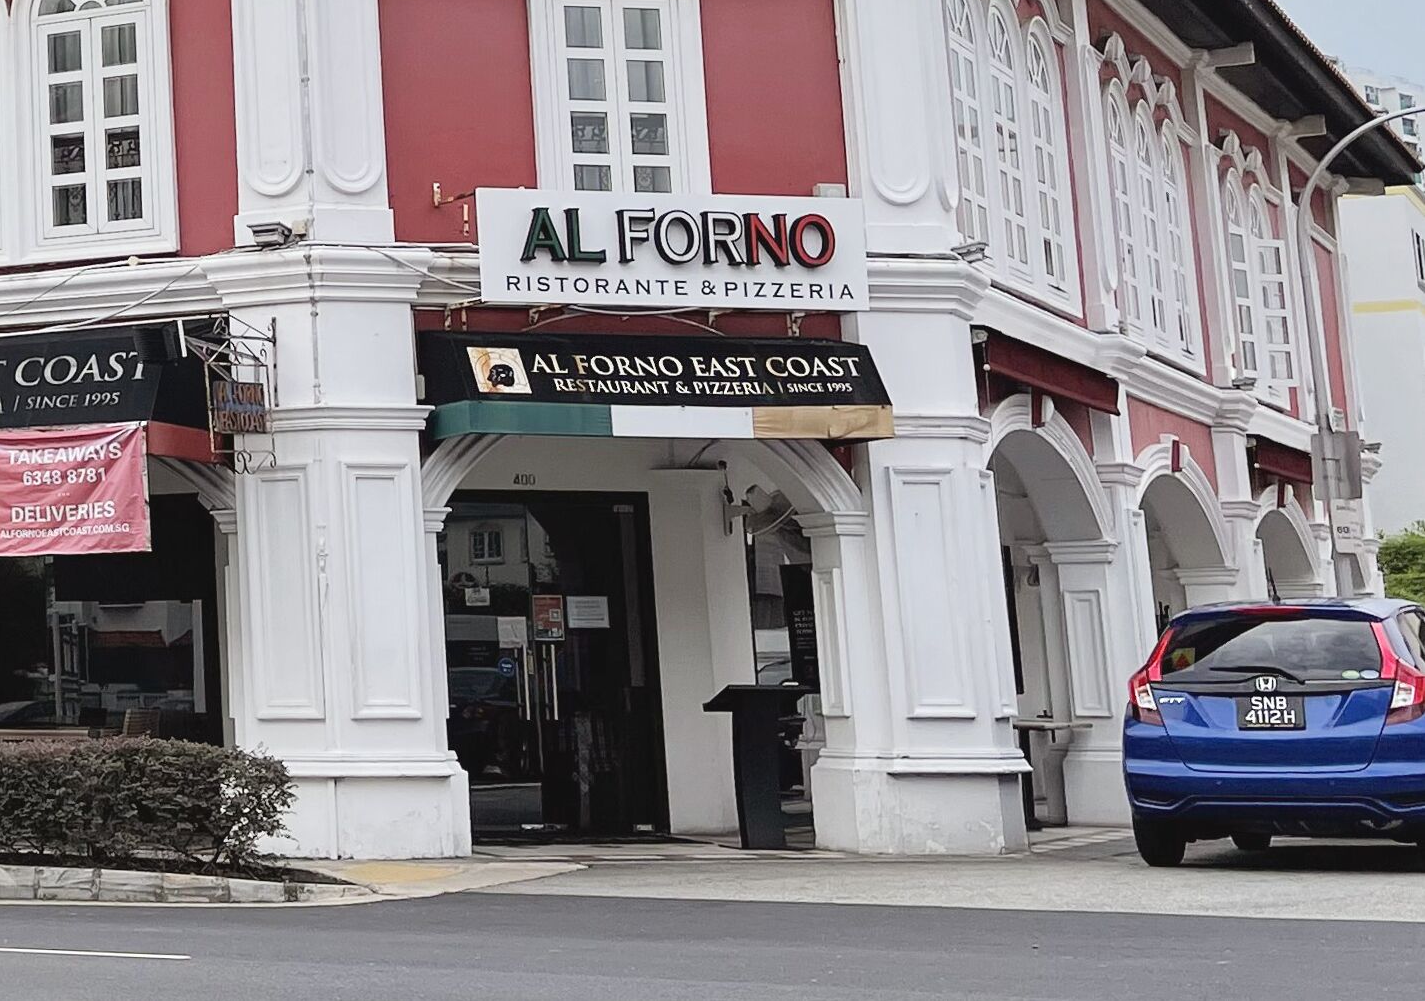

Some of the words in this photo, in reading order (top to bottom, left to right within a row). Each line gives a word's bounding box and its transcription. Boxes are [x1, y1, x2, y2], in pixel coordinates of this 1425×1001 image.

[520, 206, 606, 264] AL
[615, 207, 836, 268] FORNO
[506, 274, 690, 297] RISTORANTE
[701, 279, 718, 296] &
[724, 280, 855, 300] PIZZERIA
[15, 351, 144, 387] COAST
[531, 353, 569, 374] AL
[572, 353, 684, 377] FORNO
[692, 356, 757, 378] EAST
[765, 356, 861, 379] COAST
[554, 377, 670, 395] RESTAURANT
[675, 380, 692, 395] &
[694, 380, 774, 397] PIZZERIA
[786, 382, 824, 394] SINCE
[827, 382, 853, 394] 1995
[26, 394, 78, 410] SINCE
[83, 391, 121, 407] 1995
[8, 442, 122, 466] TAKEAWAYS
[22, 469, 62, 486] 6348
[67, 467, 106, 484] 8781
[513, 473, 536, 485] 400
[11, 501, 116, 523] DELIVERIES
[1250, 696, 1287, 710] SNB
